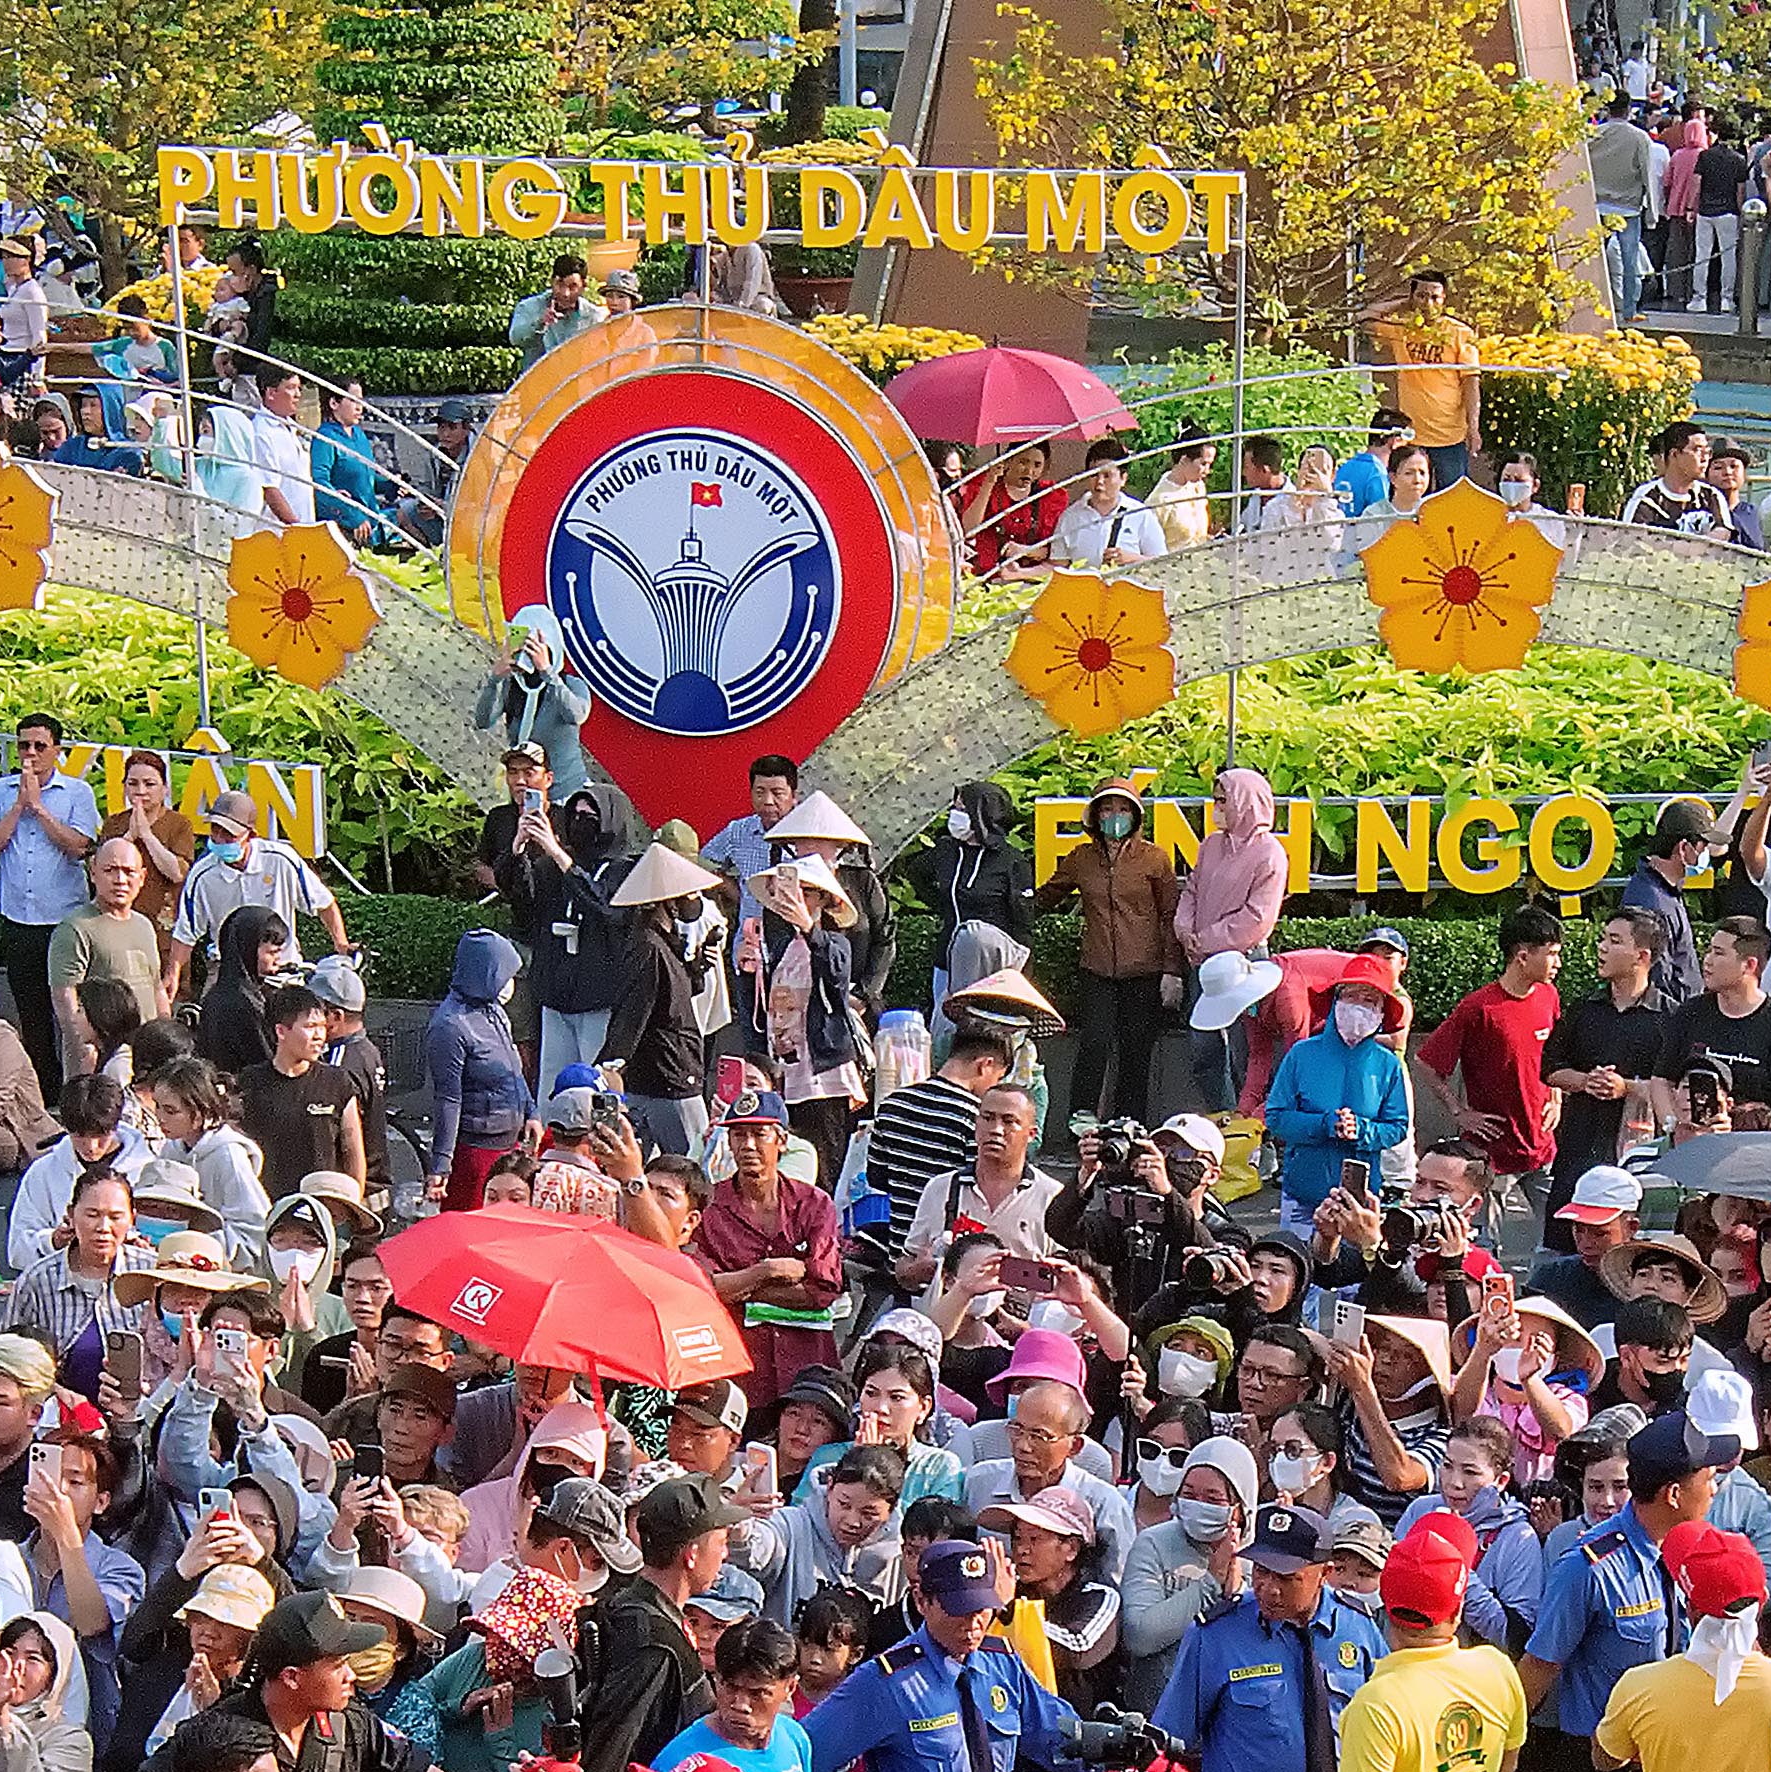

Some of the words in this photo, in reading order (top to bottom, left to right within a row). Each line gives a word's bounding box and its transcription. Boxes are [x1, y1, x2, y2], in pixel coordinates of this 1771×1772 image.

[158, 121, 568, 240] PHƯỜNG
[590, 128, 769, 247] THỦ
[801, 127, 995, 252] DẦU
[1027, 144, 1242, 283] MỘT
[586, 453, 662, 513] PHƯỜNG
[667, 444, 709, 472] THỦ
[760, 482, 799, 525] MỘT
[54, 726, 325, 859] ÂN
[1356, 794, 1616, 916] NGỌ
[1447, 1719, 1468, 1752] 89
